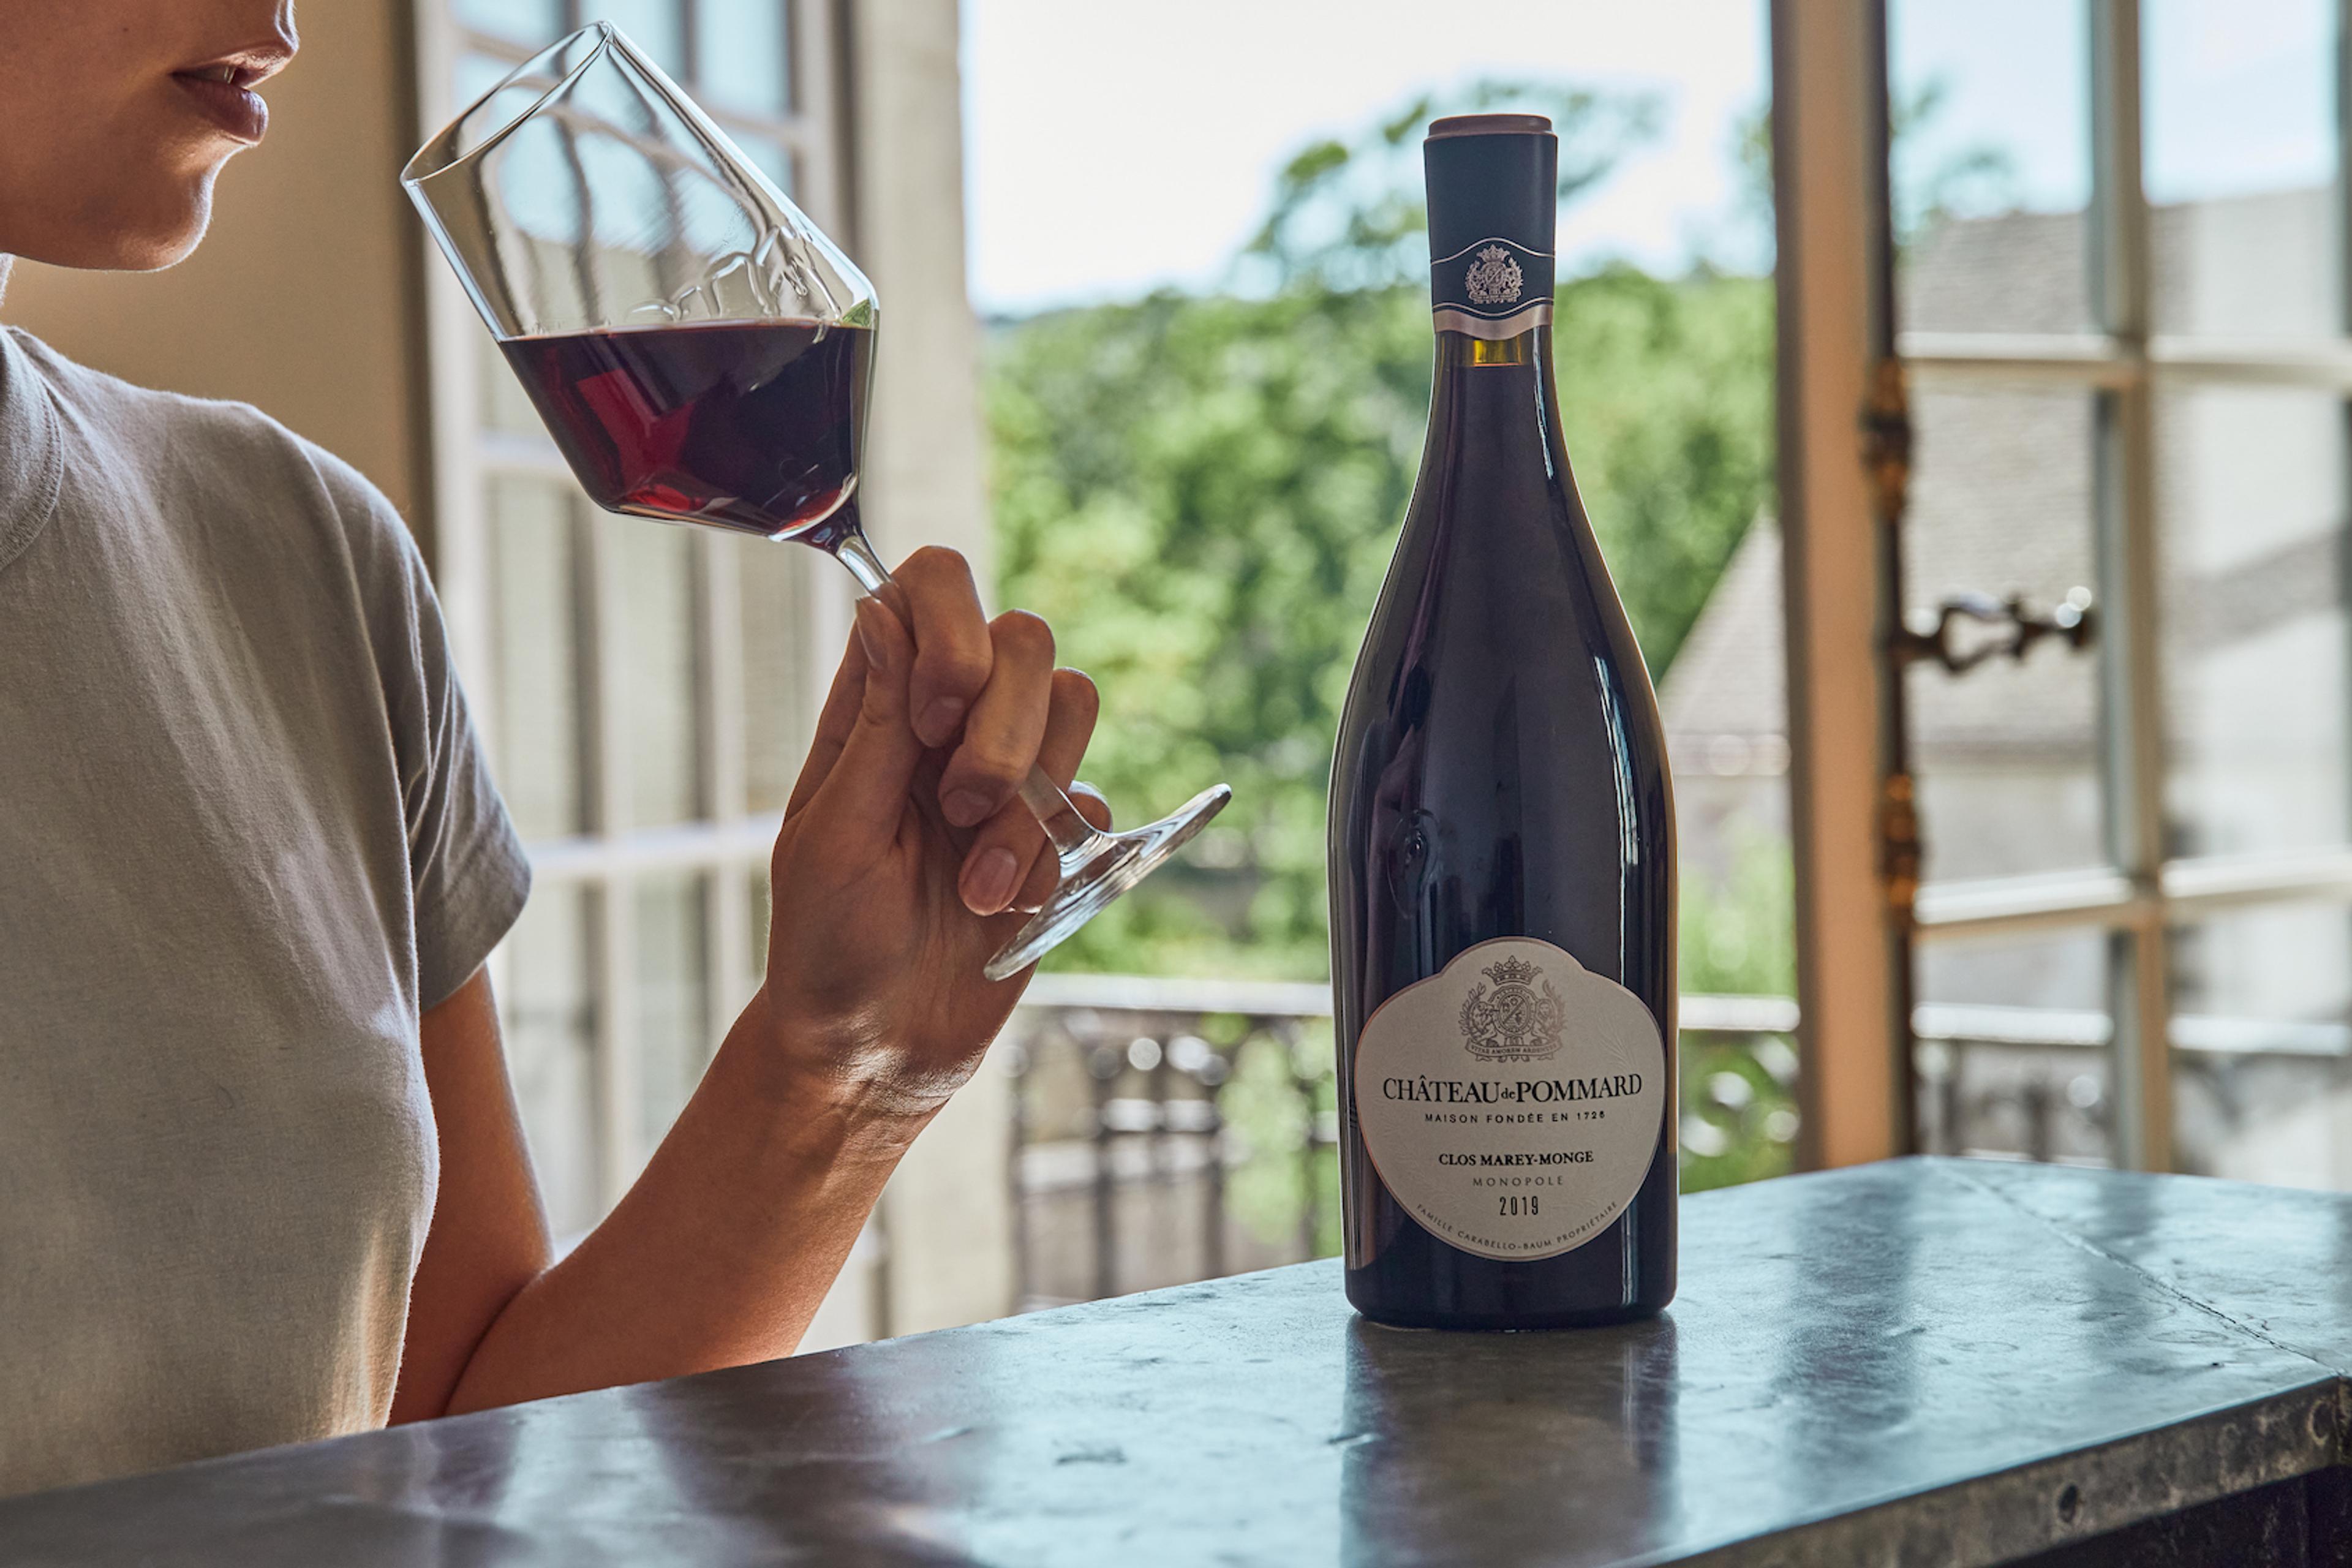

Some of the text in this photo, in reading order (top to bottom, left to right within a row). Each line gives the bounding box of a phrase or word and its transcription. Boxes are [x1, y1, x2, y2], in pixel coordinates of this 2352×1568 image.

[1383, 1073, 1642, 1103] CHÂTEAU de POMMARD
[1425, 1114, 1478, 1123] MAISON
[1487, 1113, 1544, 1123] FONDÉE
[1551, 1113, 1568, 1122] EN
[1439, 1151, 1594, 1166] CLOS MAREY-MONGE
[1472, 1175, 1563, 1187] MONOPOLE
[1499, 1196, 1539, 1216] 2019
[1416, 1201, 1618, 1250] FAMILLE CARABELLO-BAUM PROPRIÉTAIRE
